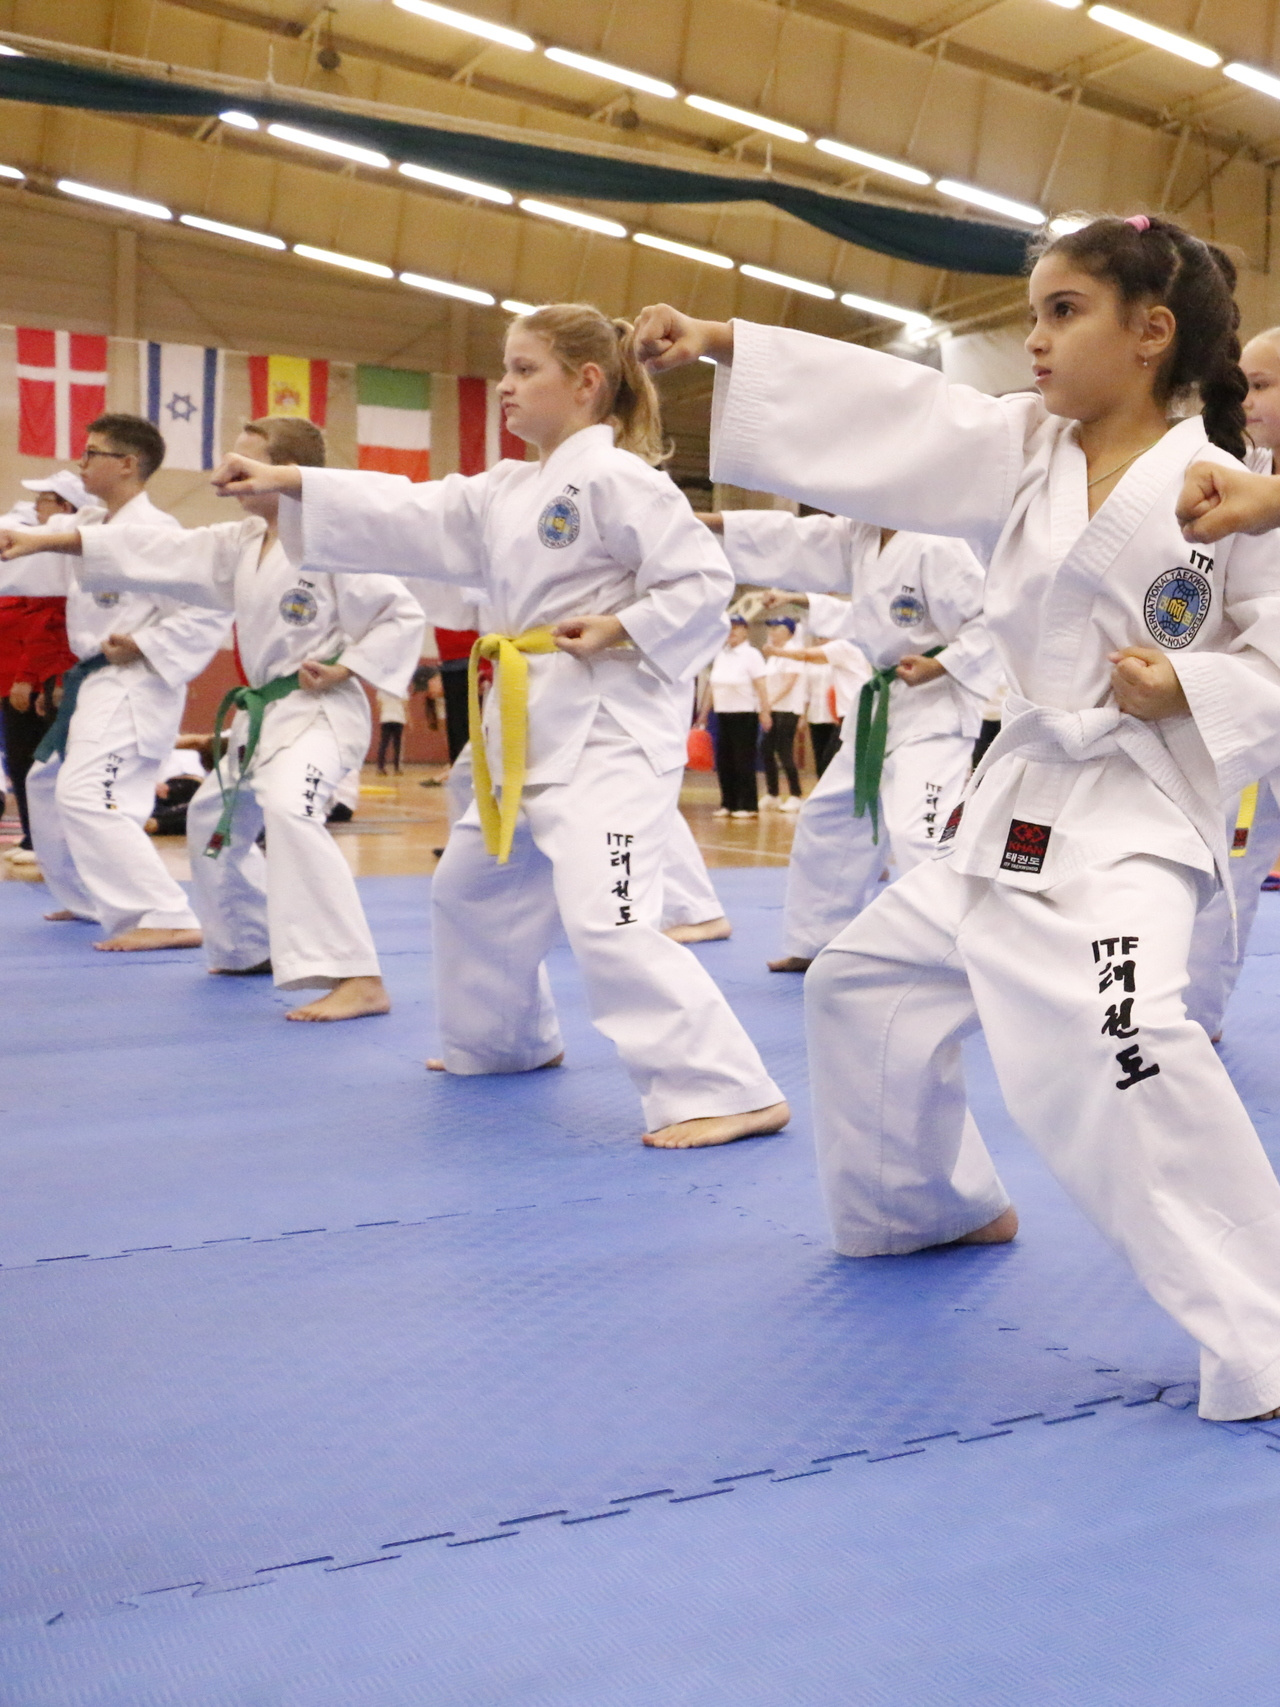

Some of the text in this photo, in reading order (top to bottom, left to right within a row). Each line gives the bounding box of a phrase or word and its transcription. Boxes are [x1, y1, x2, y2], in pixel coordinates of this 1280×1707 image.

[607, 832, 634, 847] ITF
[1005, 852, 1040, 866] 태권도
[1091, 936, 1139, 963] ITF
